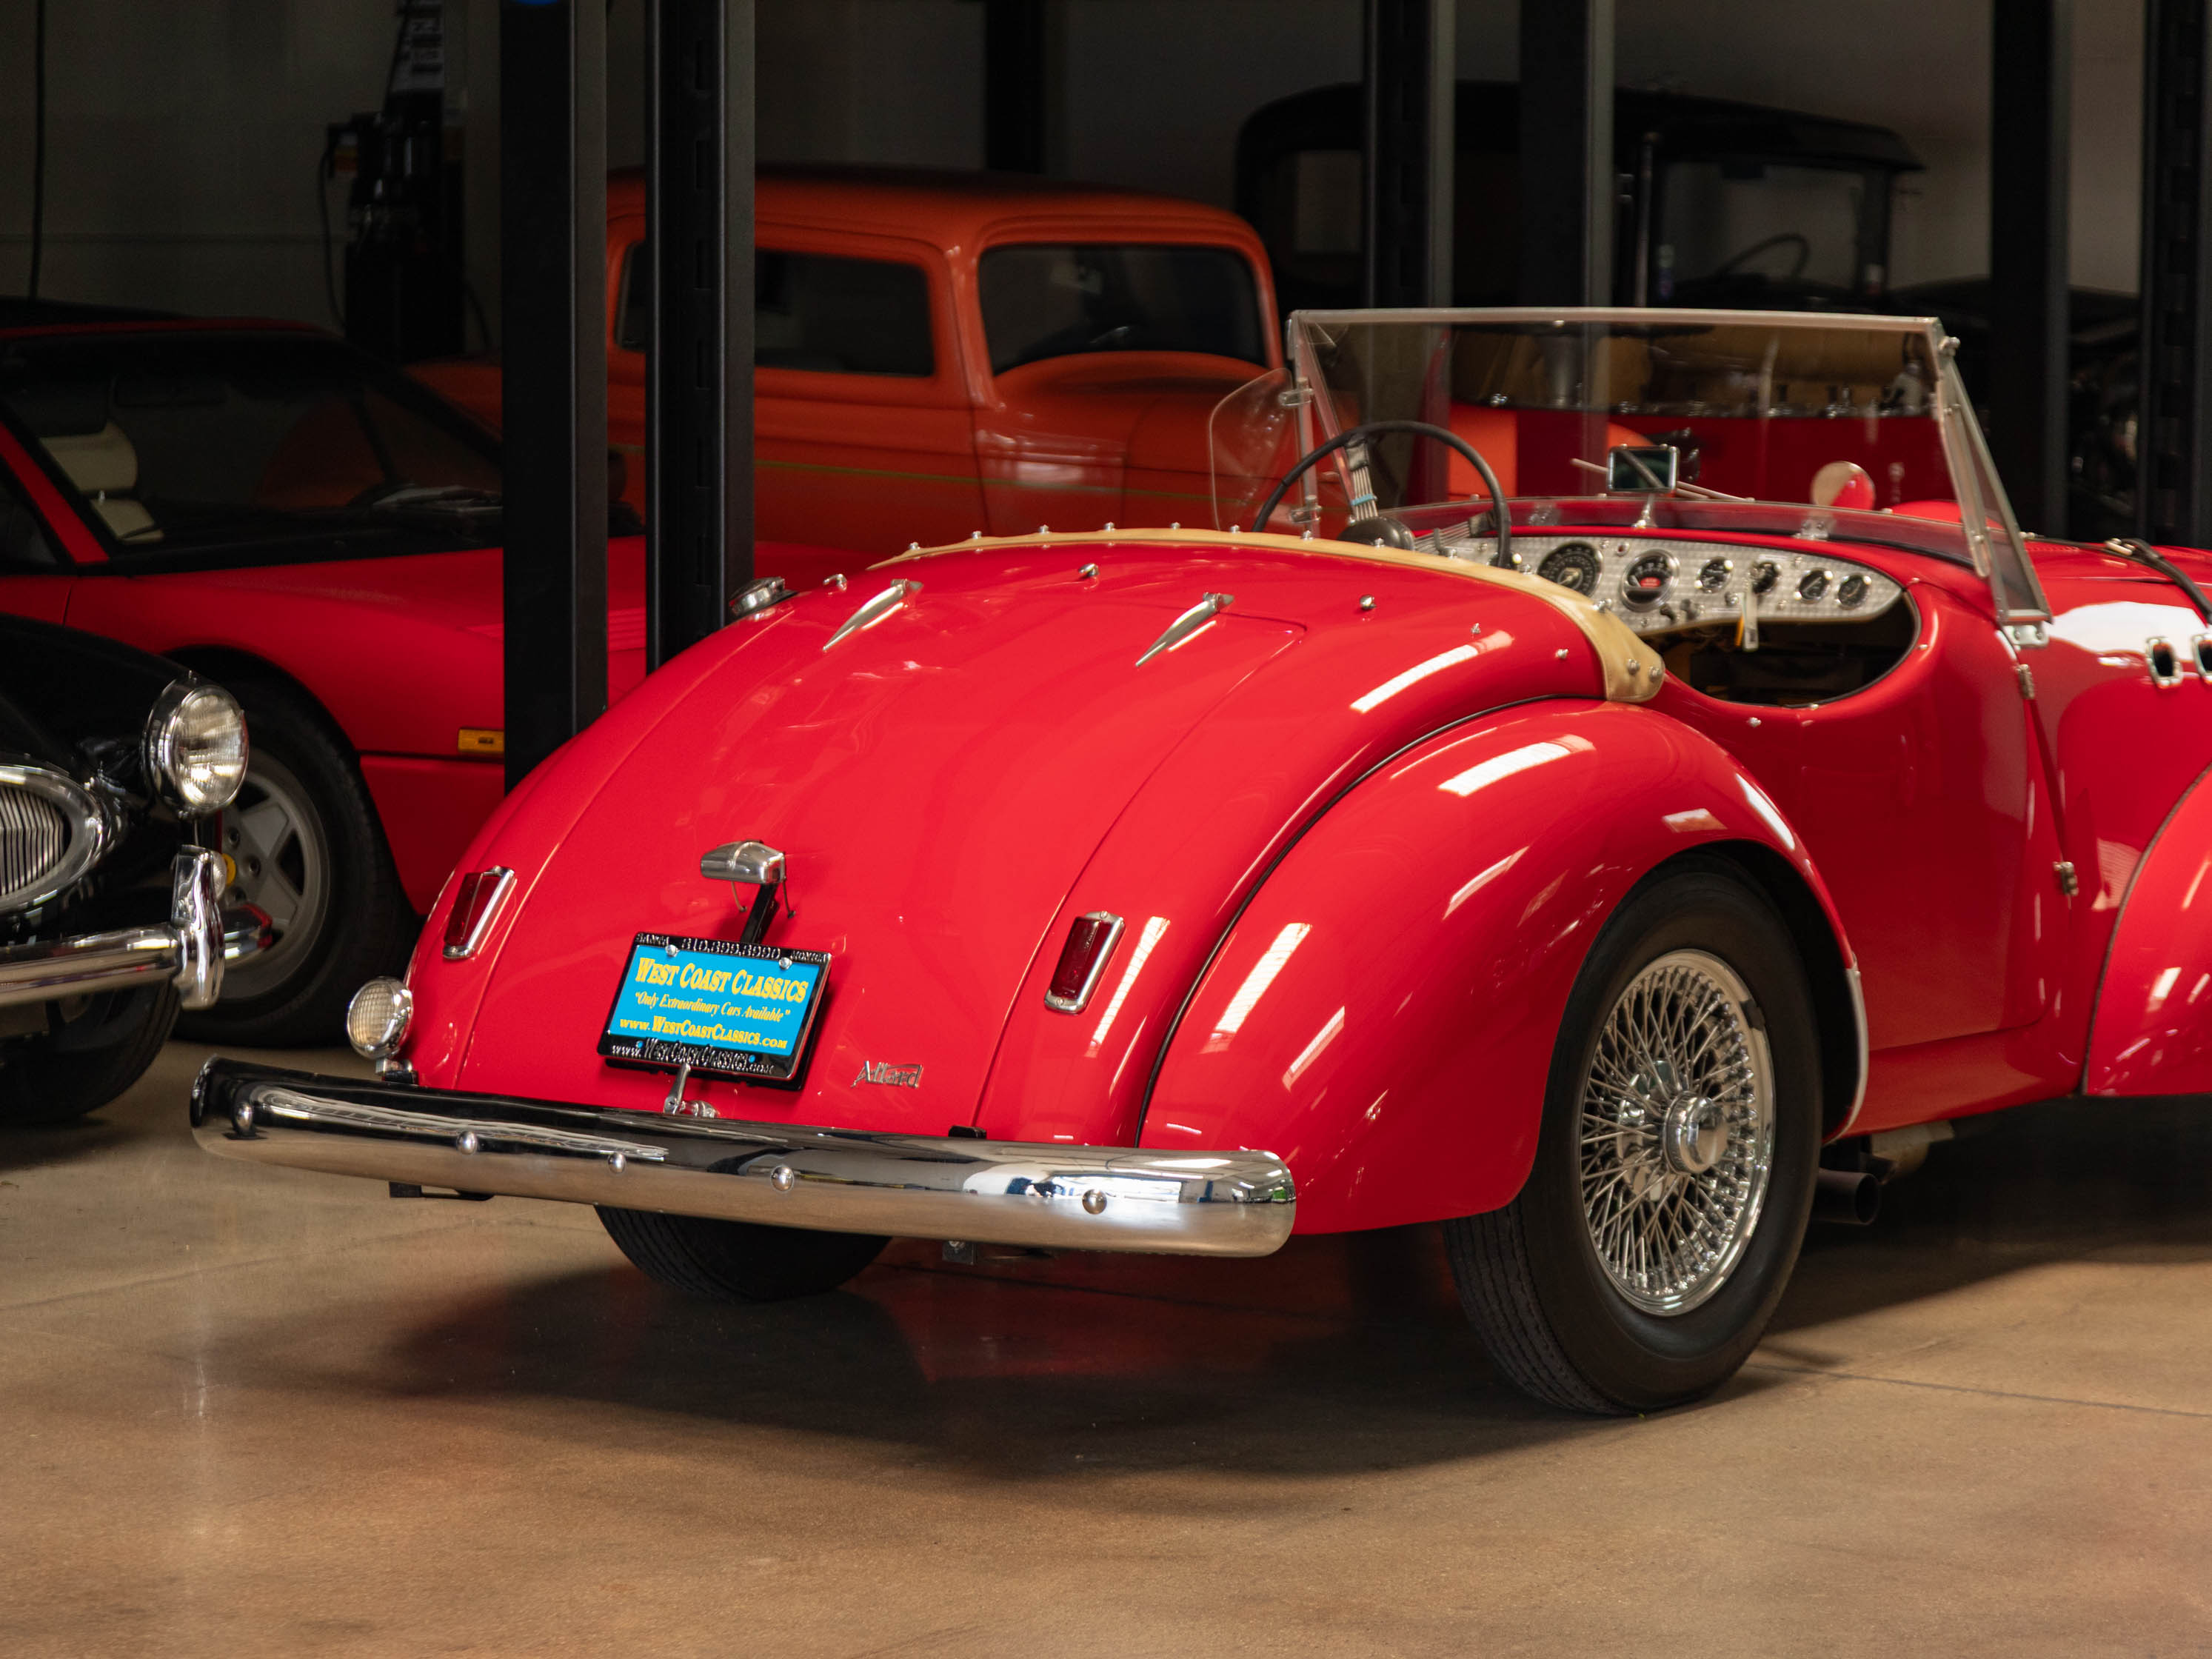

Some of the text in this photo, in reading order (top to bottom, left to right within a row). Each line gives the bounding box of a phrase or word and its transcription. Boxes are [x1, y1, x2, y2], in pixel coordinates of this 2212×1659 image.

[659, 994, 720, 1017] Extraordinary
[721, 1002, 742, 1016] Cars
[850, 1060, 923, 1089] Allard
